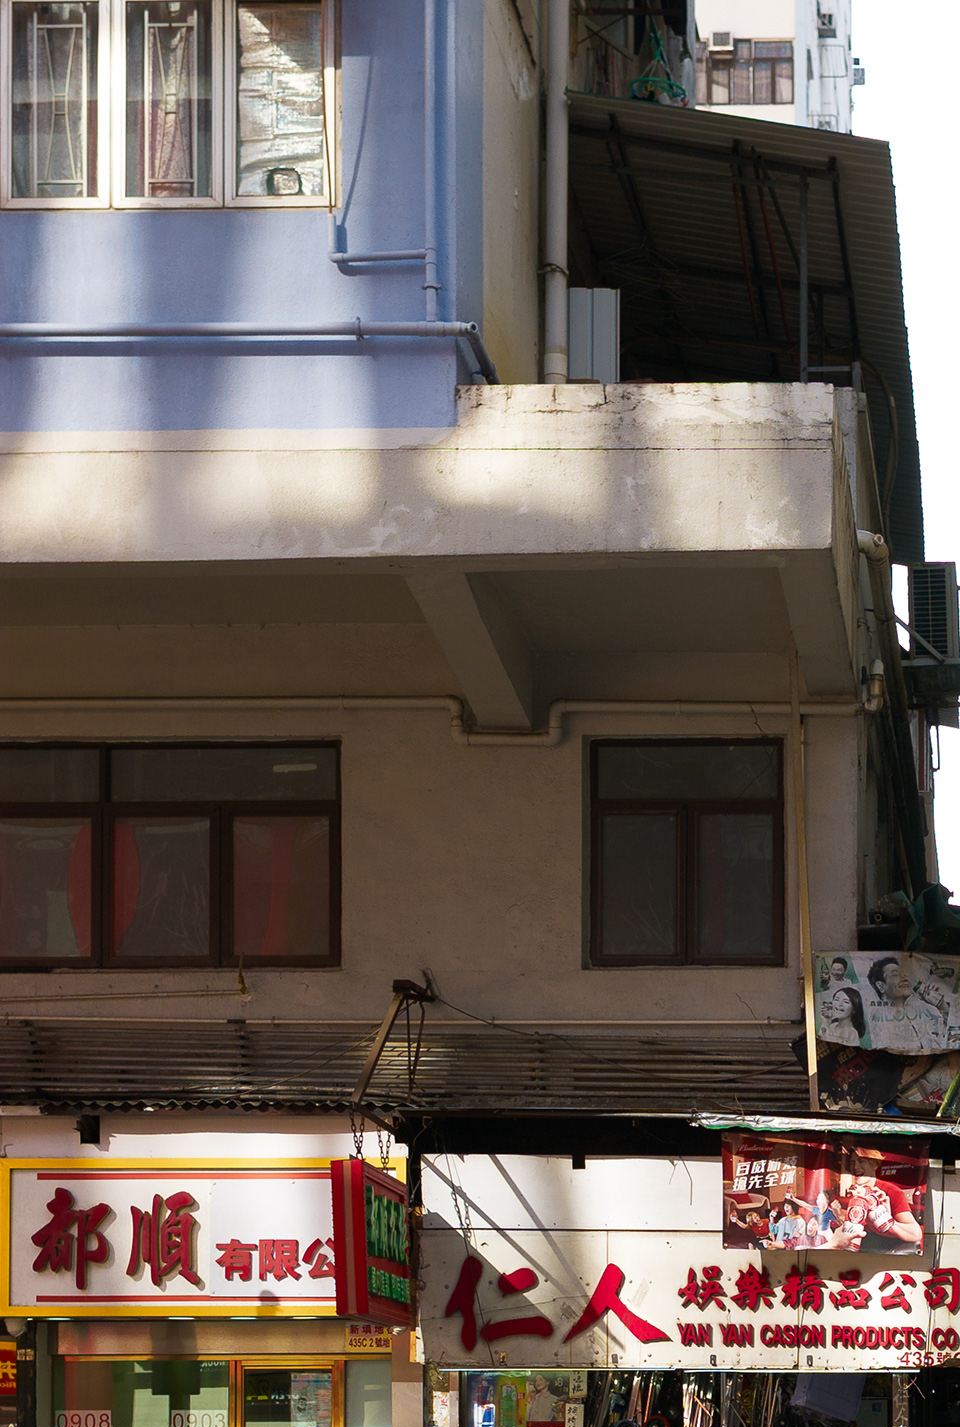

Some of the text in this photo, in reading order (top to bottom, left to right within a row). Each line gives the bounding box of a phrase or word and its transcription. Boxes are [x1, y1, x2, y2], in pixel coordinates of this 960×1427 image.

[31, 1187, 204, 1290] 都順
[445, 1255, 673, 1352] 仁人
[677, 1323, 960, 1351] YAN YAN CASION PRODUCTS CO
